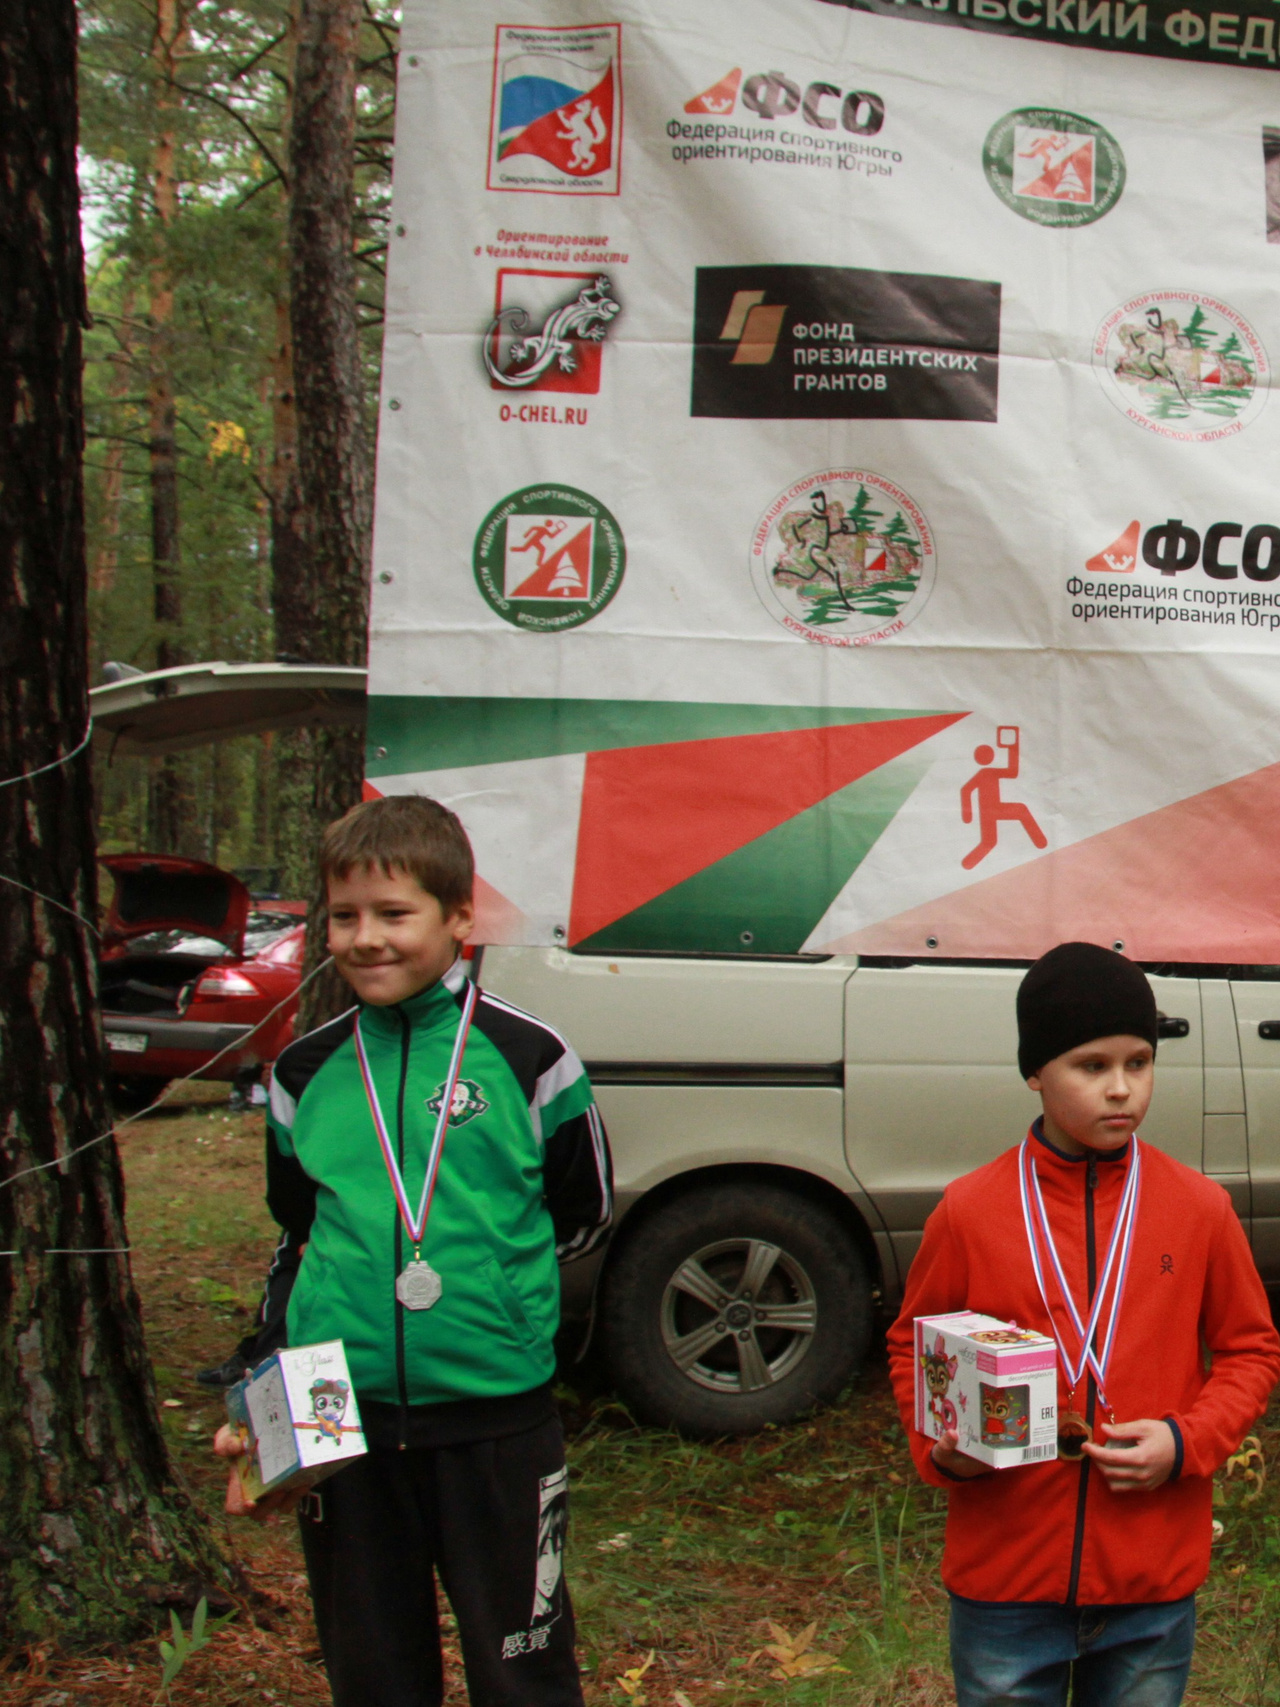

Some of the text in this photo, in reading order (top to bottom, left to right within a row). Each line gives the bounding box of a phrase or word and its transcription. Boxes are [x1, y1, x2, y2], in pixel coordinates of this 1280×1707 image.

[741, 69, 886, 137] ФСО
[666, 119, 903, 163] Федерация спортивного
[672, 144, 893, 177] ориентирования Югры
[497, 229, 609, 247] Ориентирование
[474, 245, 629, 263] в Челябинской области
[1123, 291, 1200, 313] СПОРТИВНОГО
[793, 323, 855, 341] ФОНД
[793, 348, 978, 372] ПРЕЗИДЕНТСКИХ
[793, 374, 887, 391] ГРАНТОВ
[500, 404, 588, 425] O-CHEL.RU
[480, 502, 518, 558] ФЕДЕРАЦИЯ
[523, 490, 598, 515] СПОРТИВНОГО
[753, 470, 933, 556] ФЕДЕРАЦИЯ СПОРТИВНОГО ОРИЕНТИРОВАНИЯ
[1066, 576, 1178, 602] Федерация
[1072, 602, 1236, 625] ориентирования
[782, 615, 906, 647] КУРГАНСКОЙ ОБЛАСТИ
[502, 1626, 551, 1660] 感覚
